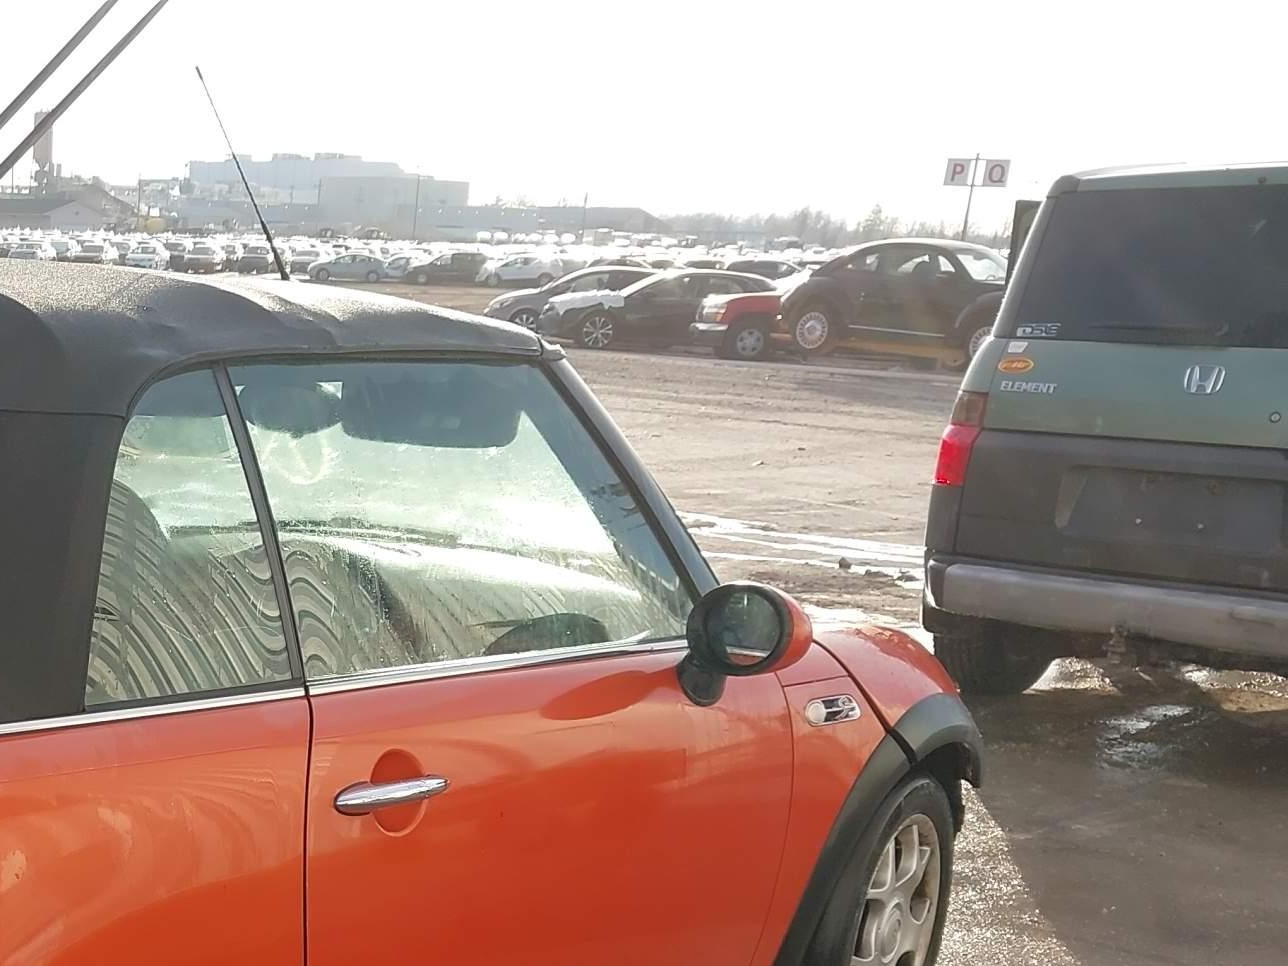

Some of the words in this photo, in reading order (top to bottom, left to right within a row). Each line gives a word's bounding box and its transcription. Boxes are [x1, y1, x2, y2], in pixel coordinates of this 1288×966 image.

[950, 163, 965, 182] P
[988, 163, 1006, 183] Q
[999, 380, 1058, 394] ELEMENT
